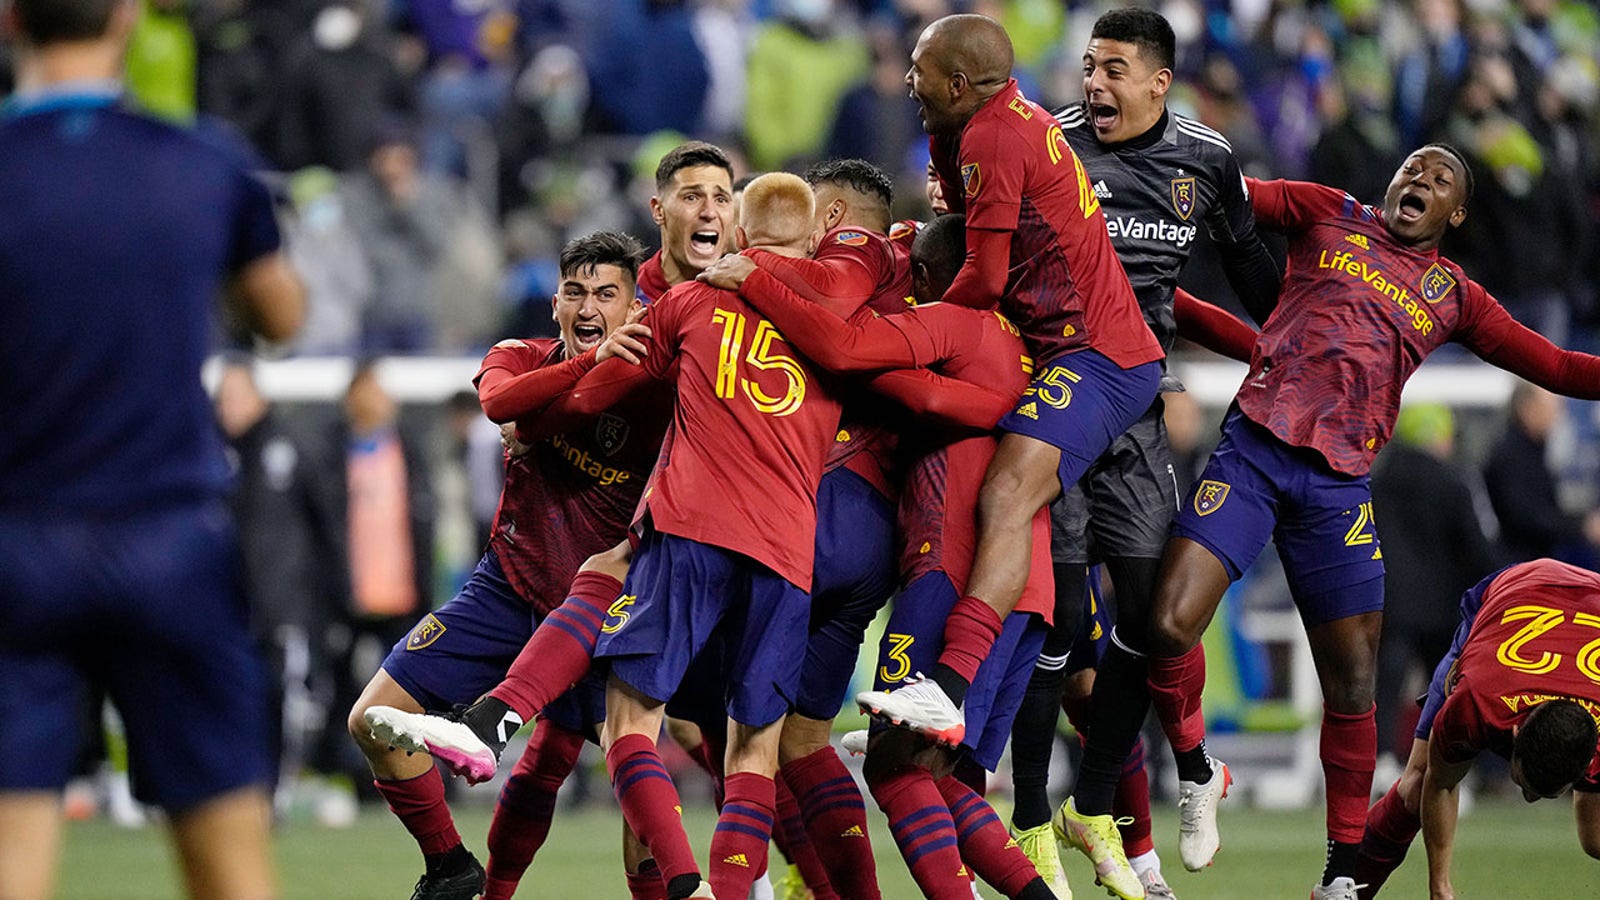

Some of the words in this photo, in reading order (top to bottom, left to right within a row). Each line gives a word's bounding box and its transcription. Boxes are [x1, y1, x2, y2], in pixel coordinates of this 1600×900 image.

[1102, 212, 1197, 247] eVantage
[1318, 249, 1434, 337] LifeVantage
[711, 307, 808, 417] 15
[880, 632, 916, 684] 3
